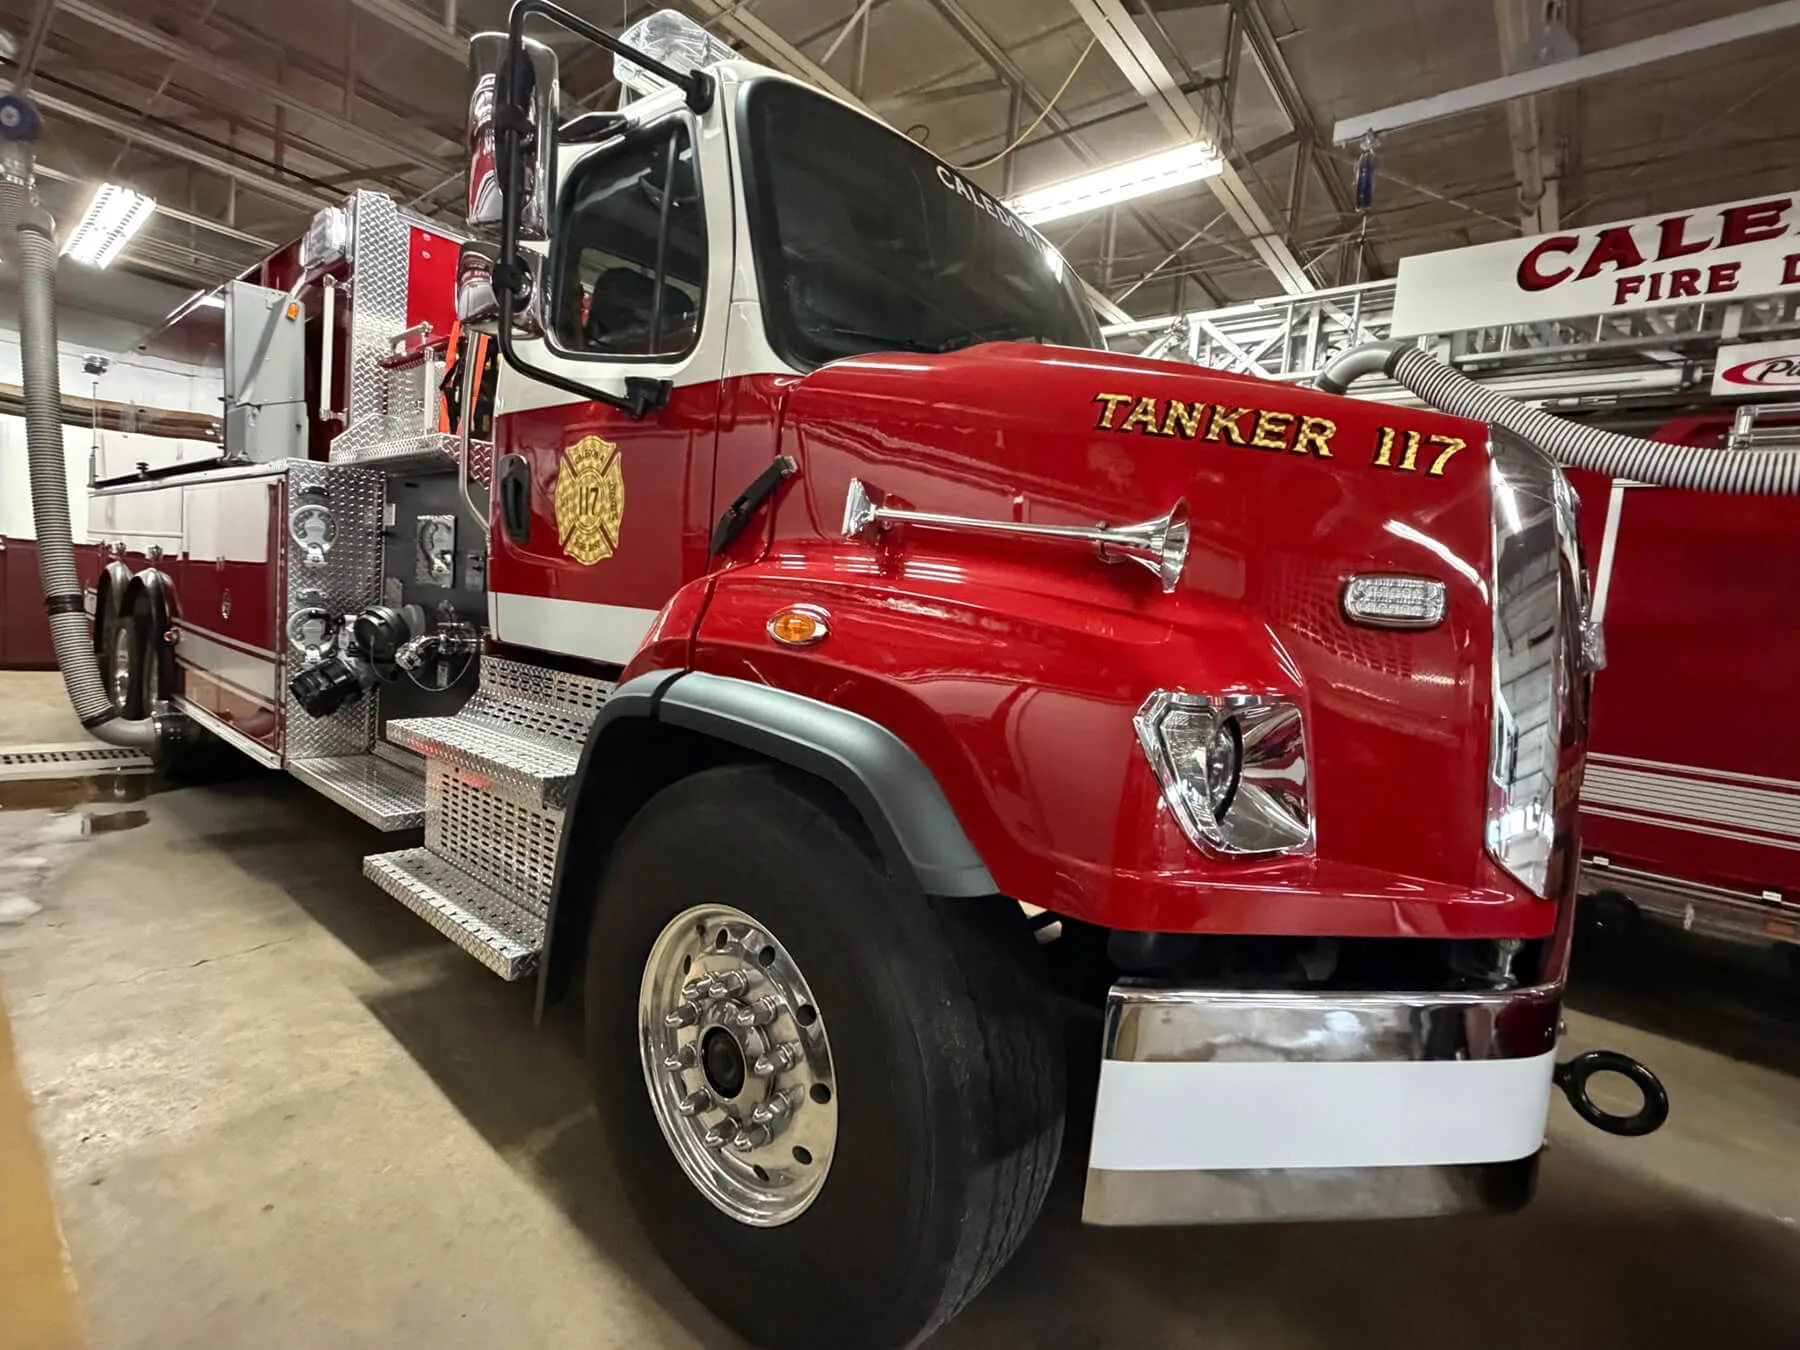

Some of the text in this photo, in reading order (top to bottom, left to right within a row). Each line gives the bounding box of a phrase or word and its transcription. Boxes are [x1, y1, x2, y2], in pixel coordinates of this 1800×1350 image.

[1516, 198, 1800, 292] CALE
[1612, 261, 1742, 305] FIRE
[1093, 393, 1467, 477] TANKER 117
[579, 486, 599, 516] 117
